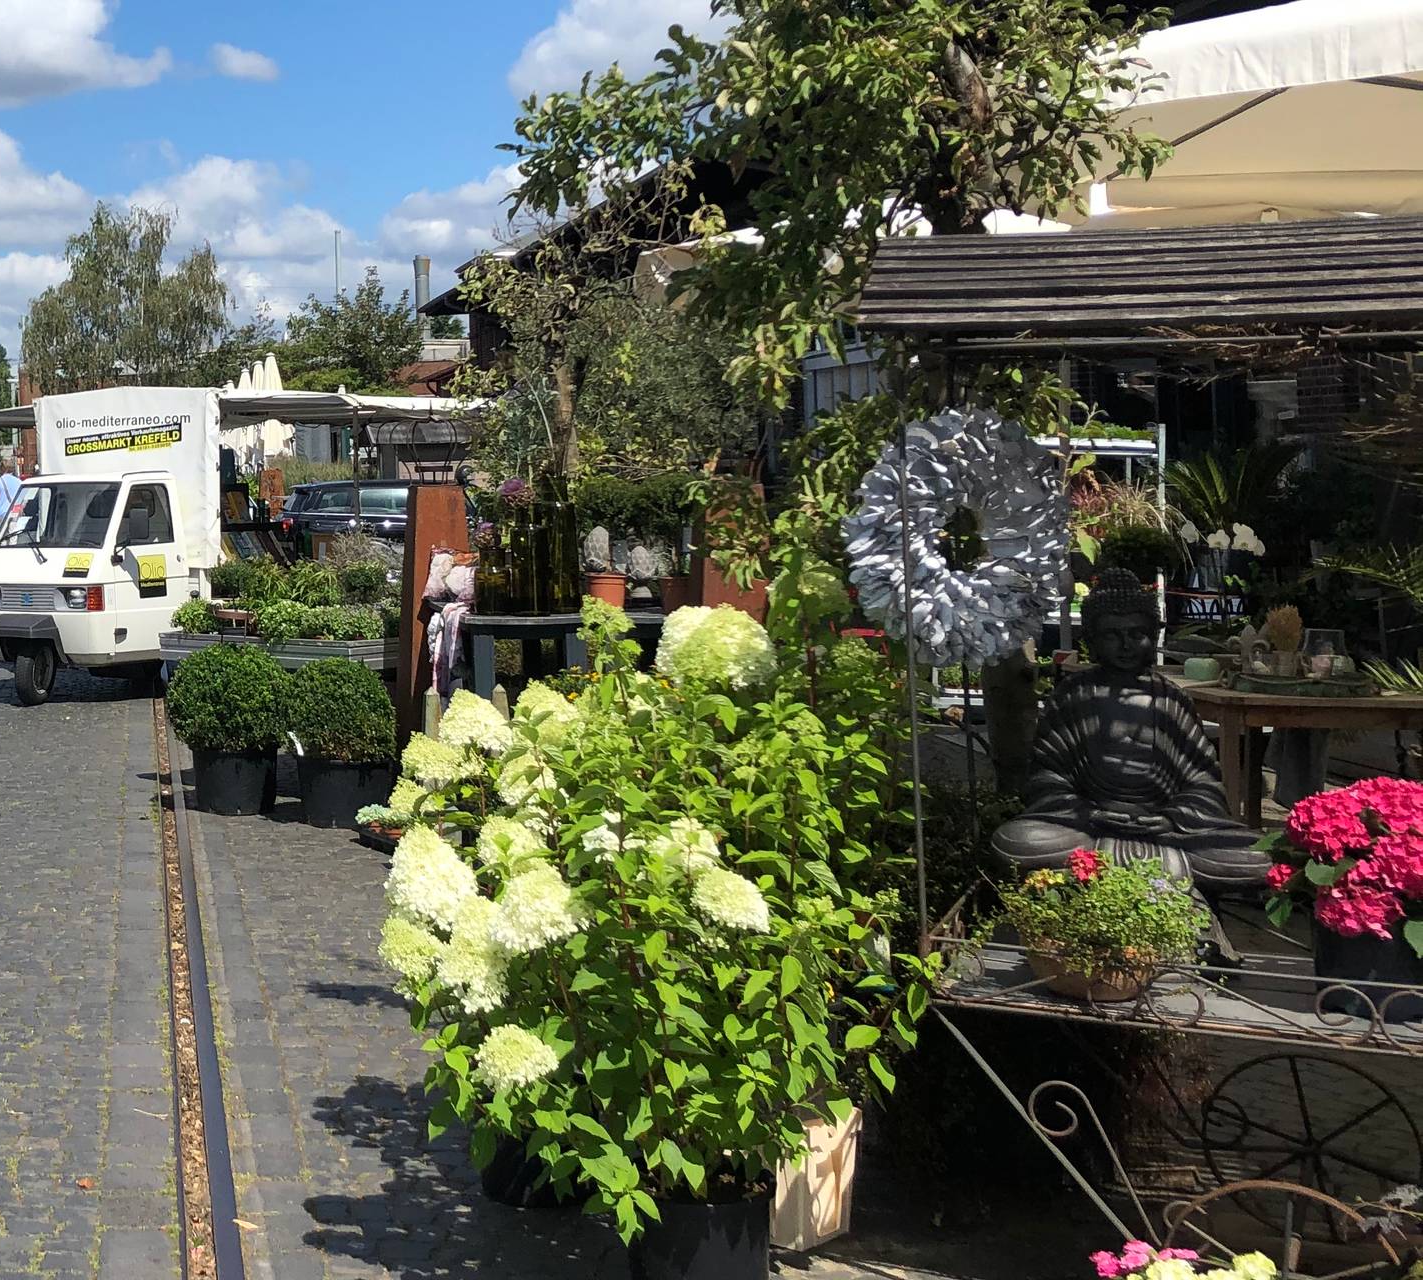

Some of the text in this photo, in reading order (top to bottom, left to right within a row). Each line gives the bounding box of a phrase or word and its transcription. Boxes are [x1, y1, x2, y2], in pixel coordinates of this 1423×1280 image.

[56, 413, 191, 429] olio-mediterraneo.com
[67, 437, 132, 454] GROSSMARKT
[134, 430, 180, 446] KREFELD
[140, 562, 165, 579] Olio
